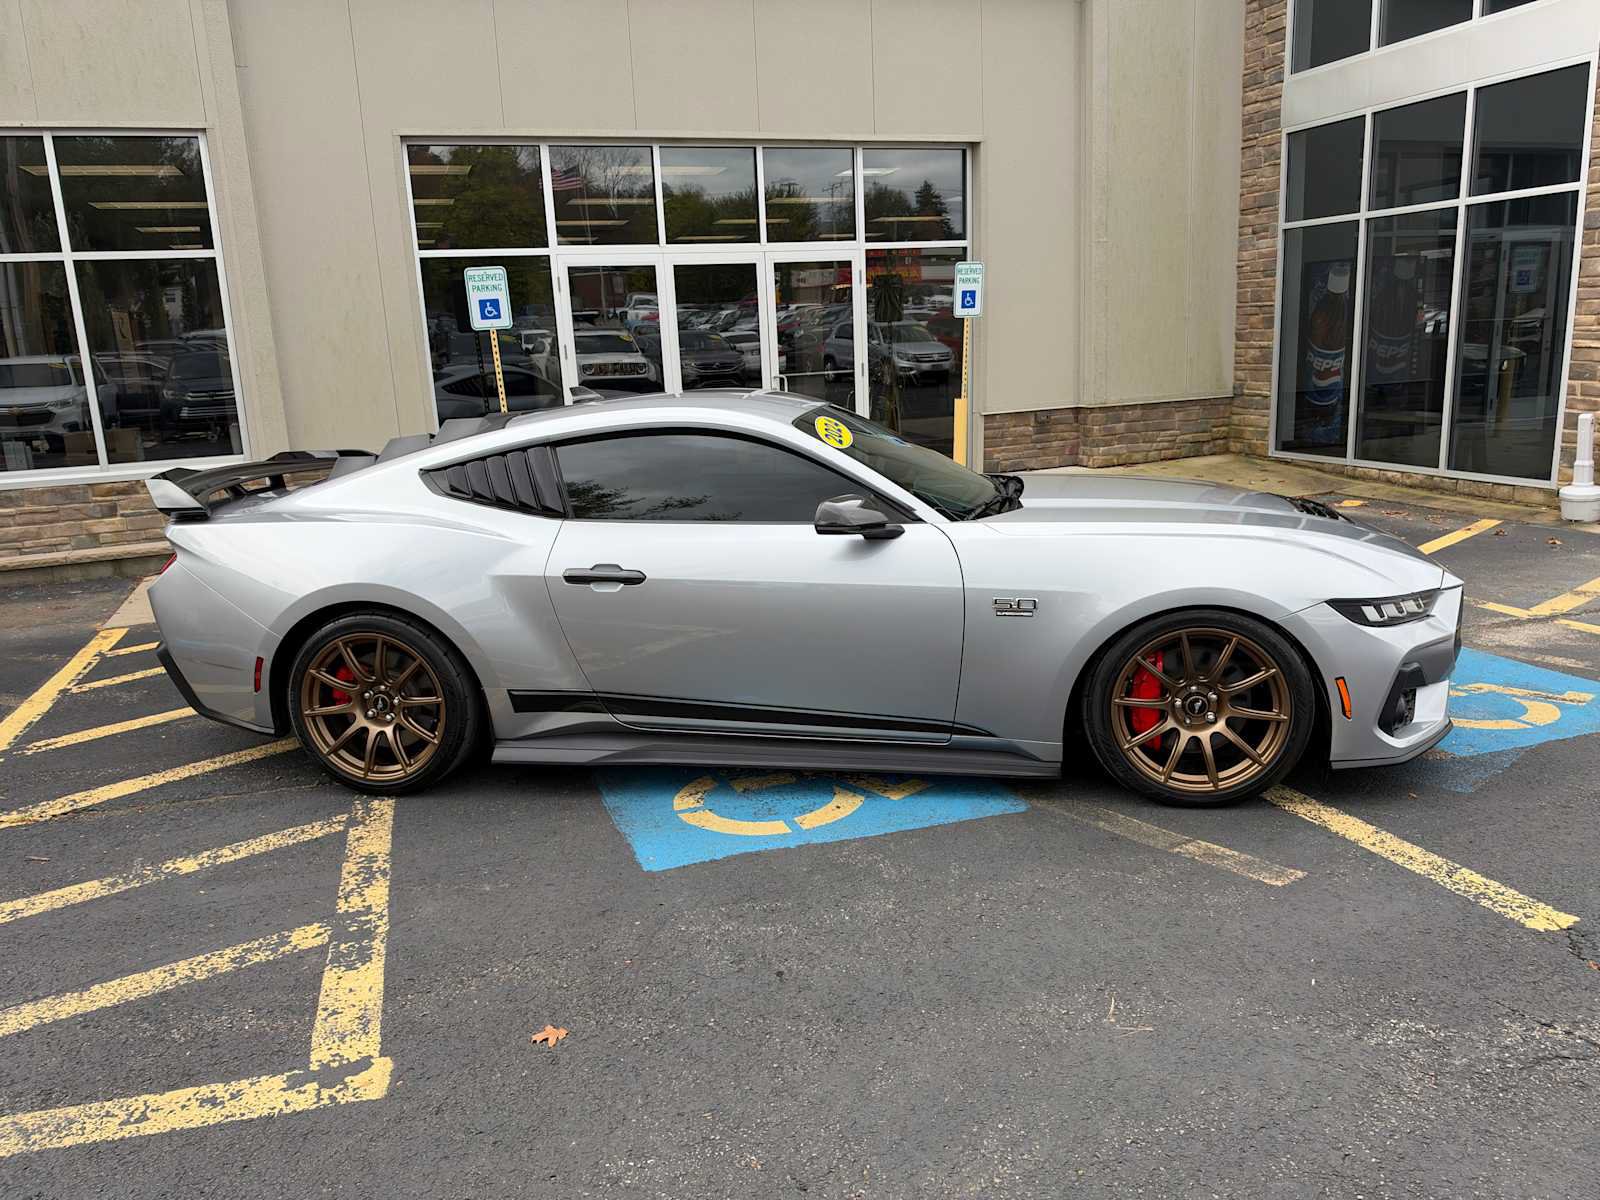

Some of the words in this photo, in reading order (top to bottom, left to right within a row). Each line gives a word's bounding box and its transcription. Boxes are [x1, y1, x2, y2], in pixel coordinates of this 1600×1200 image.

[957, 267, 982, 275] RESERVED
[467, 273, 504, 283] RESERVED
[959, 276, 980, 285] PARKING
[471, 283, 503, 293] PARKING
